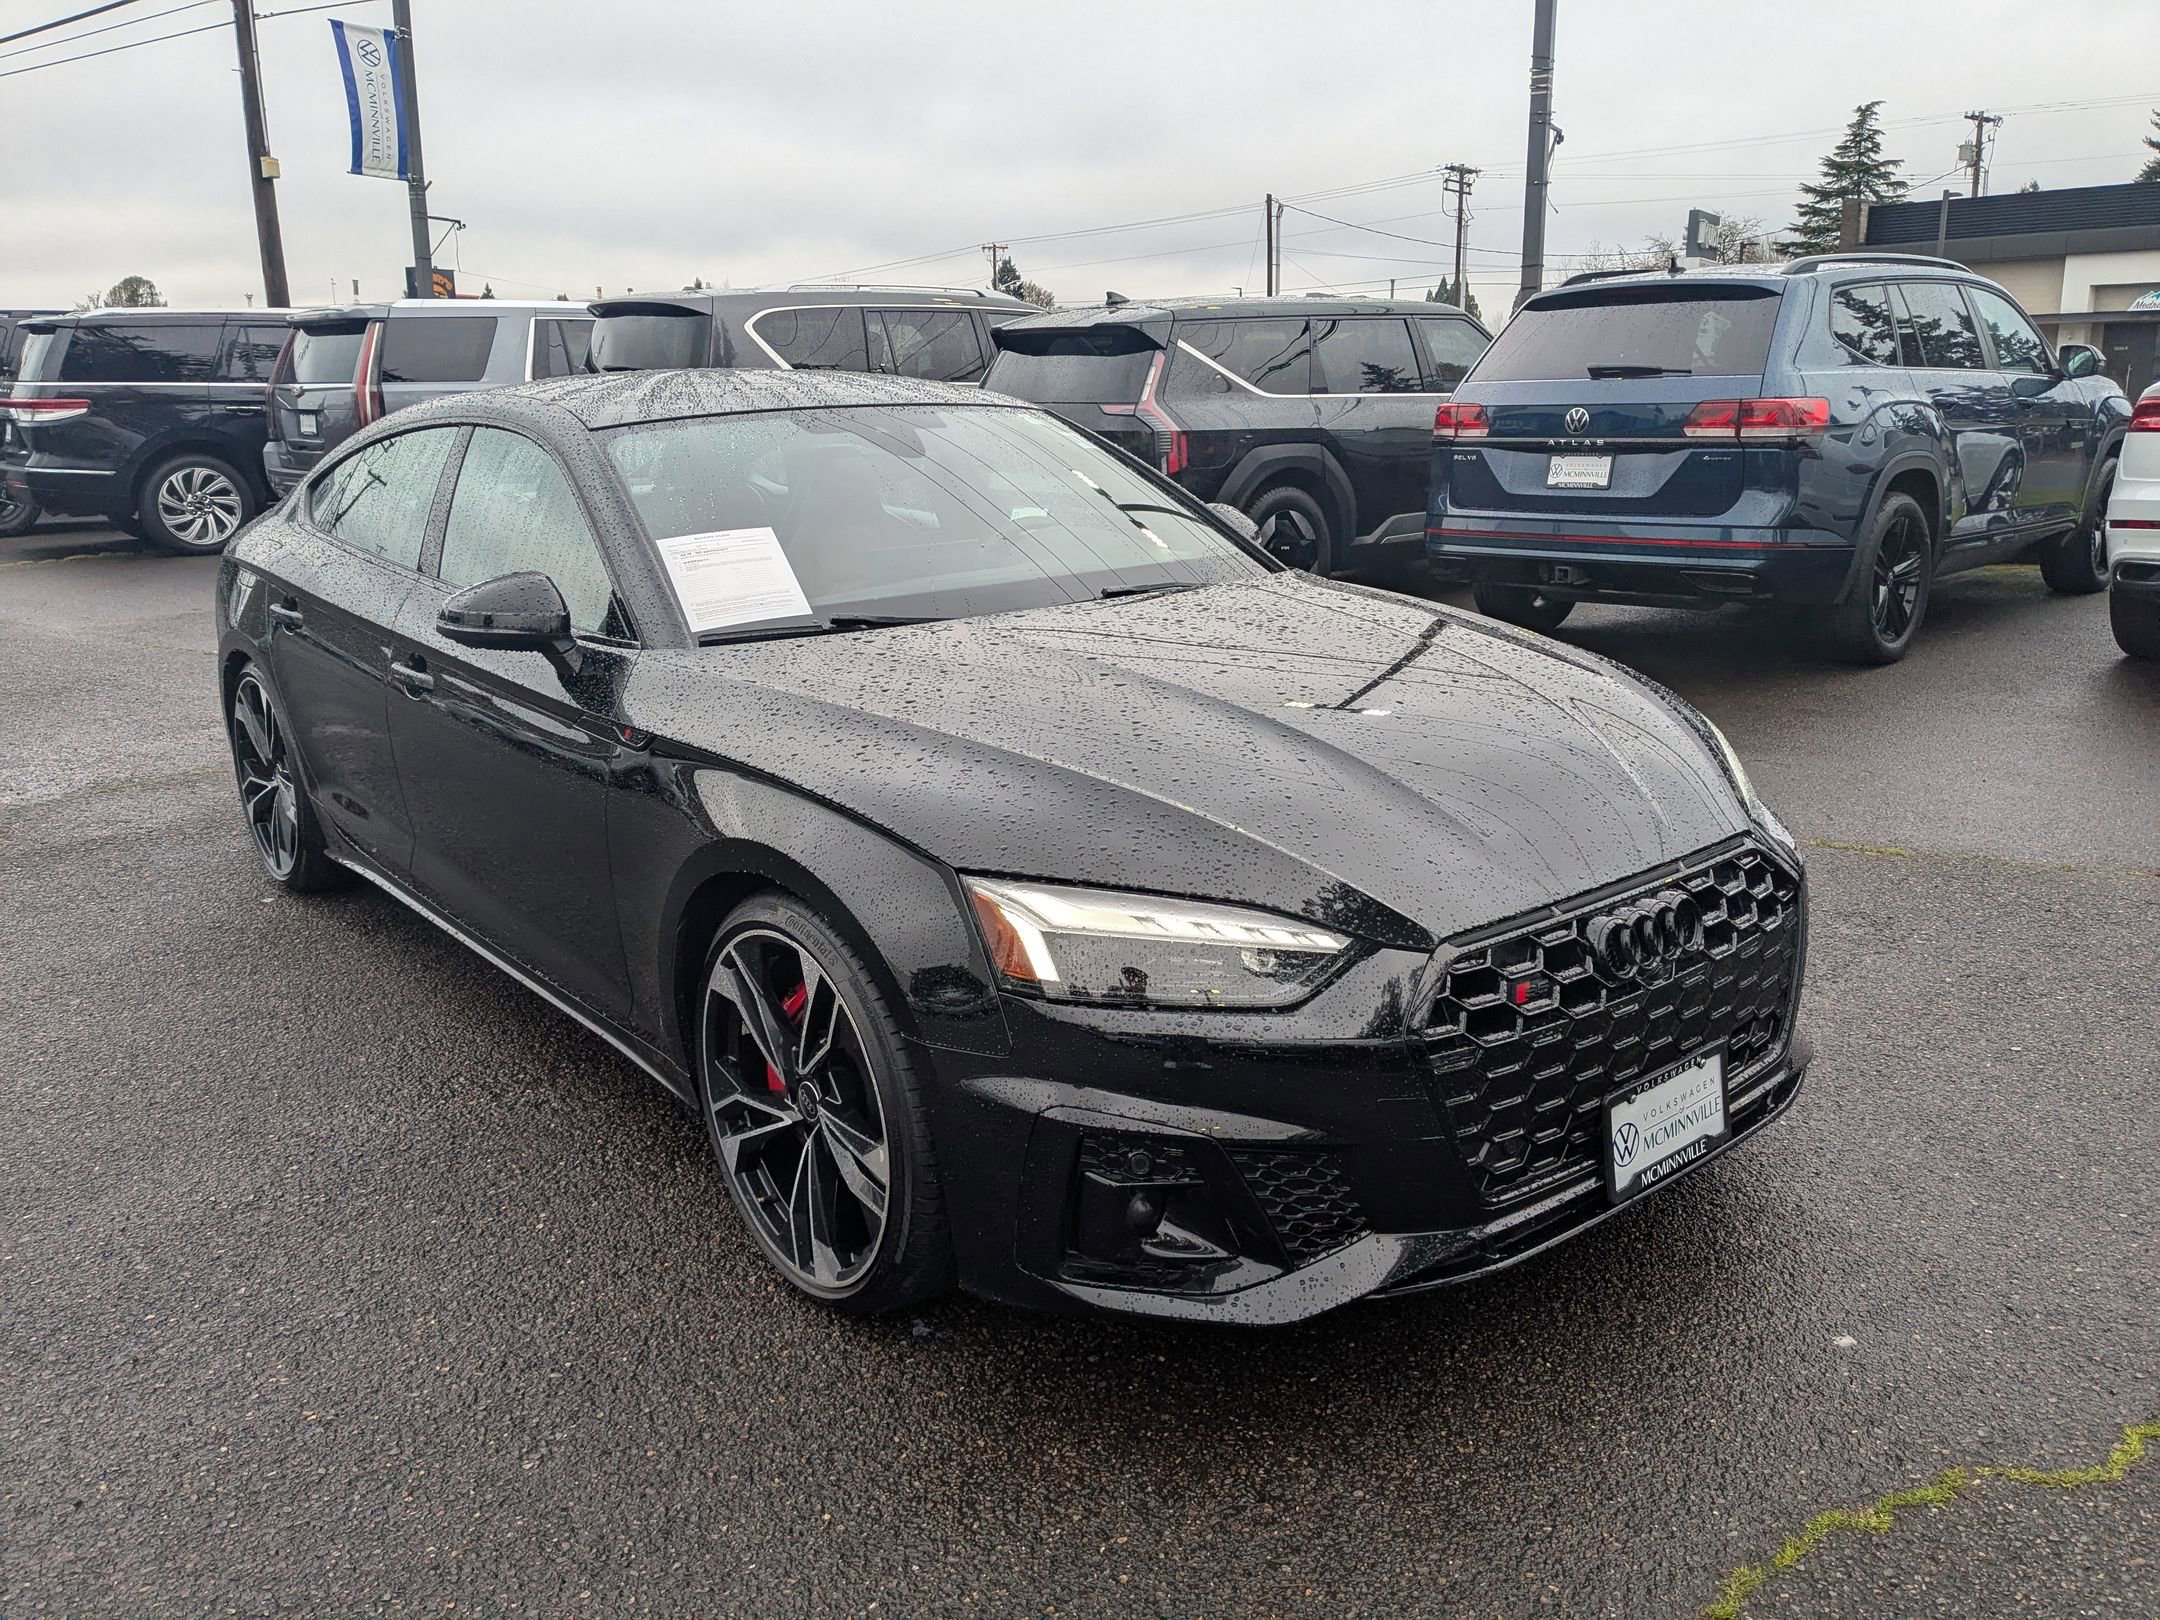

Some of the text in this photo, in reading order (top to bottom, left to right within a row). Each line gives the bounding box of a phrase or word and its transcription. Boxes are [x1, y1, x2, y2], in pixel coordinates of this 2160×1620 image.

[365, 69, 380, 163] MCMINNVILLE
[380, 74, 391, 160] VOLKSWAGEN
[1563, 470, 1608, 478] MCMINNVILLE
[785, 914, 831, 959] Continental
[1636, 1056, 1701, 1094] VOLKSWAGEN
[1642, 1077, 1716, 1122] VOLKSWAGEN
[1643, 1096, 1722, 1153] MCMINNVILLE
[1641, 1139, 1708, 1188] MCMINNVILLE
